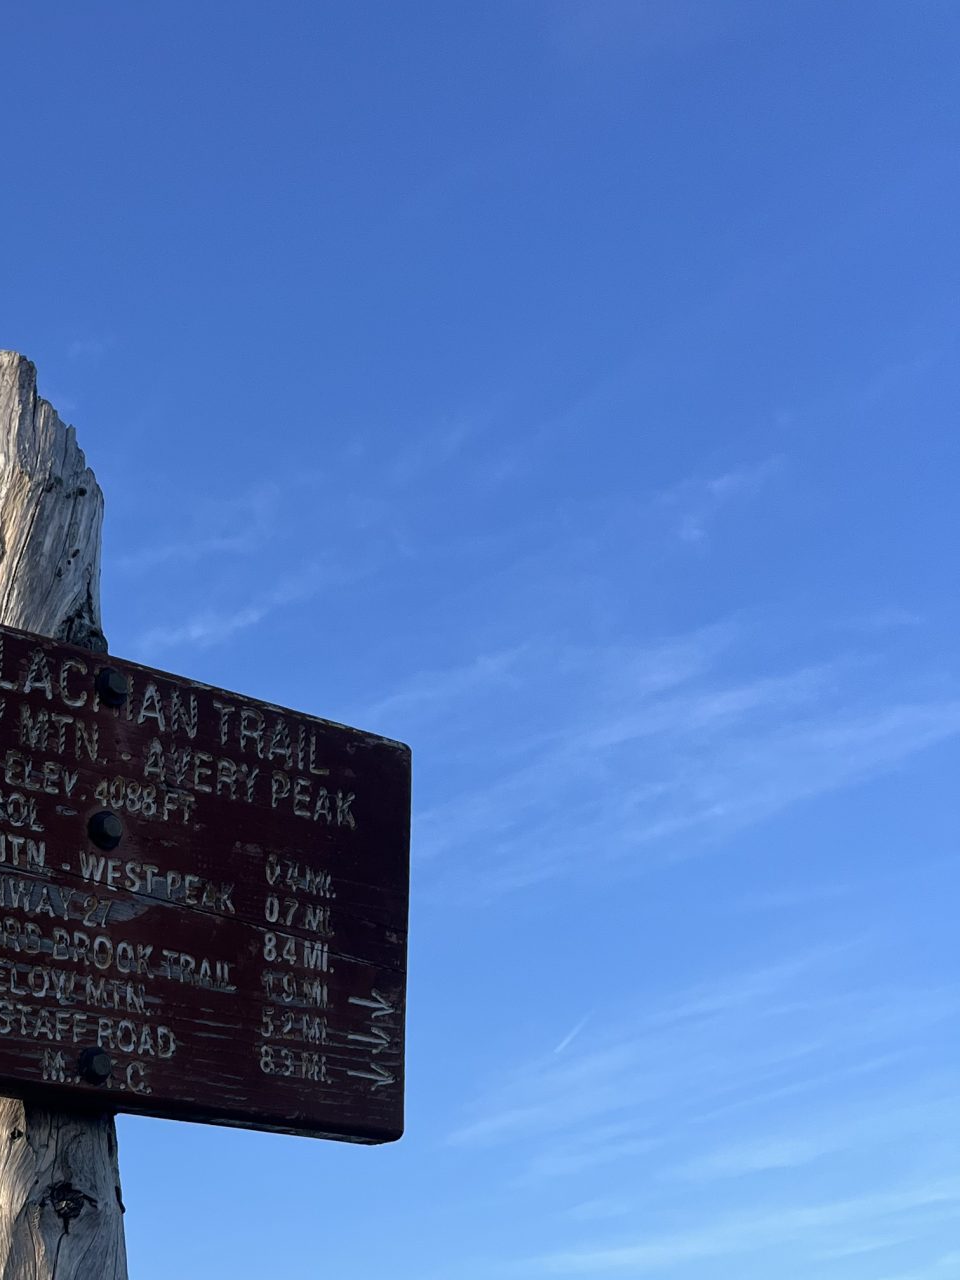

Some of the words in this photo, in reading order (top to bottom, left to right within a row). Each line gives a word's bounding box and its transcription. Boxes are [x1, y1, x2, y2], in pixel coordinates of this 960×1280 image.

[213, 701, 330, 775] TRAIL
[144, 737, 260, 802] AVERY
[271, 770, 357, 830] PEAK
[79, 850, 159, 893] WEST
[166, 869, 236, 914] PEAK
[52, 927, 155, 979] BROOK
[162, 950, 238, 994] TRAIL
[83, 896, 113, 928] 27
[263, 931, 297, 965] 8.4
[303, 939, 335, 974] MI.
[96, 1015, 177, 1059] ROAD
